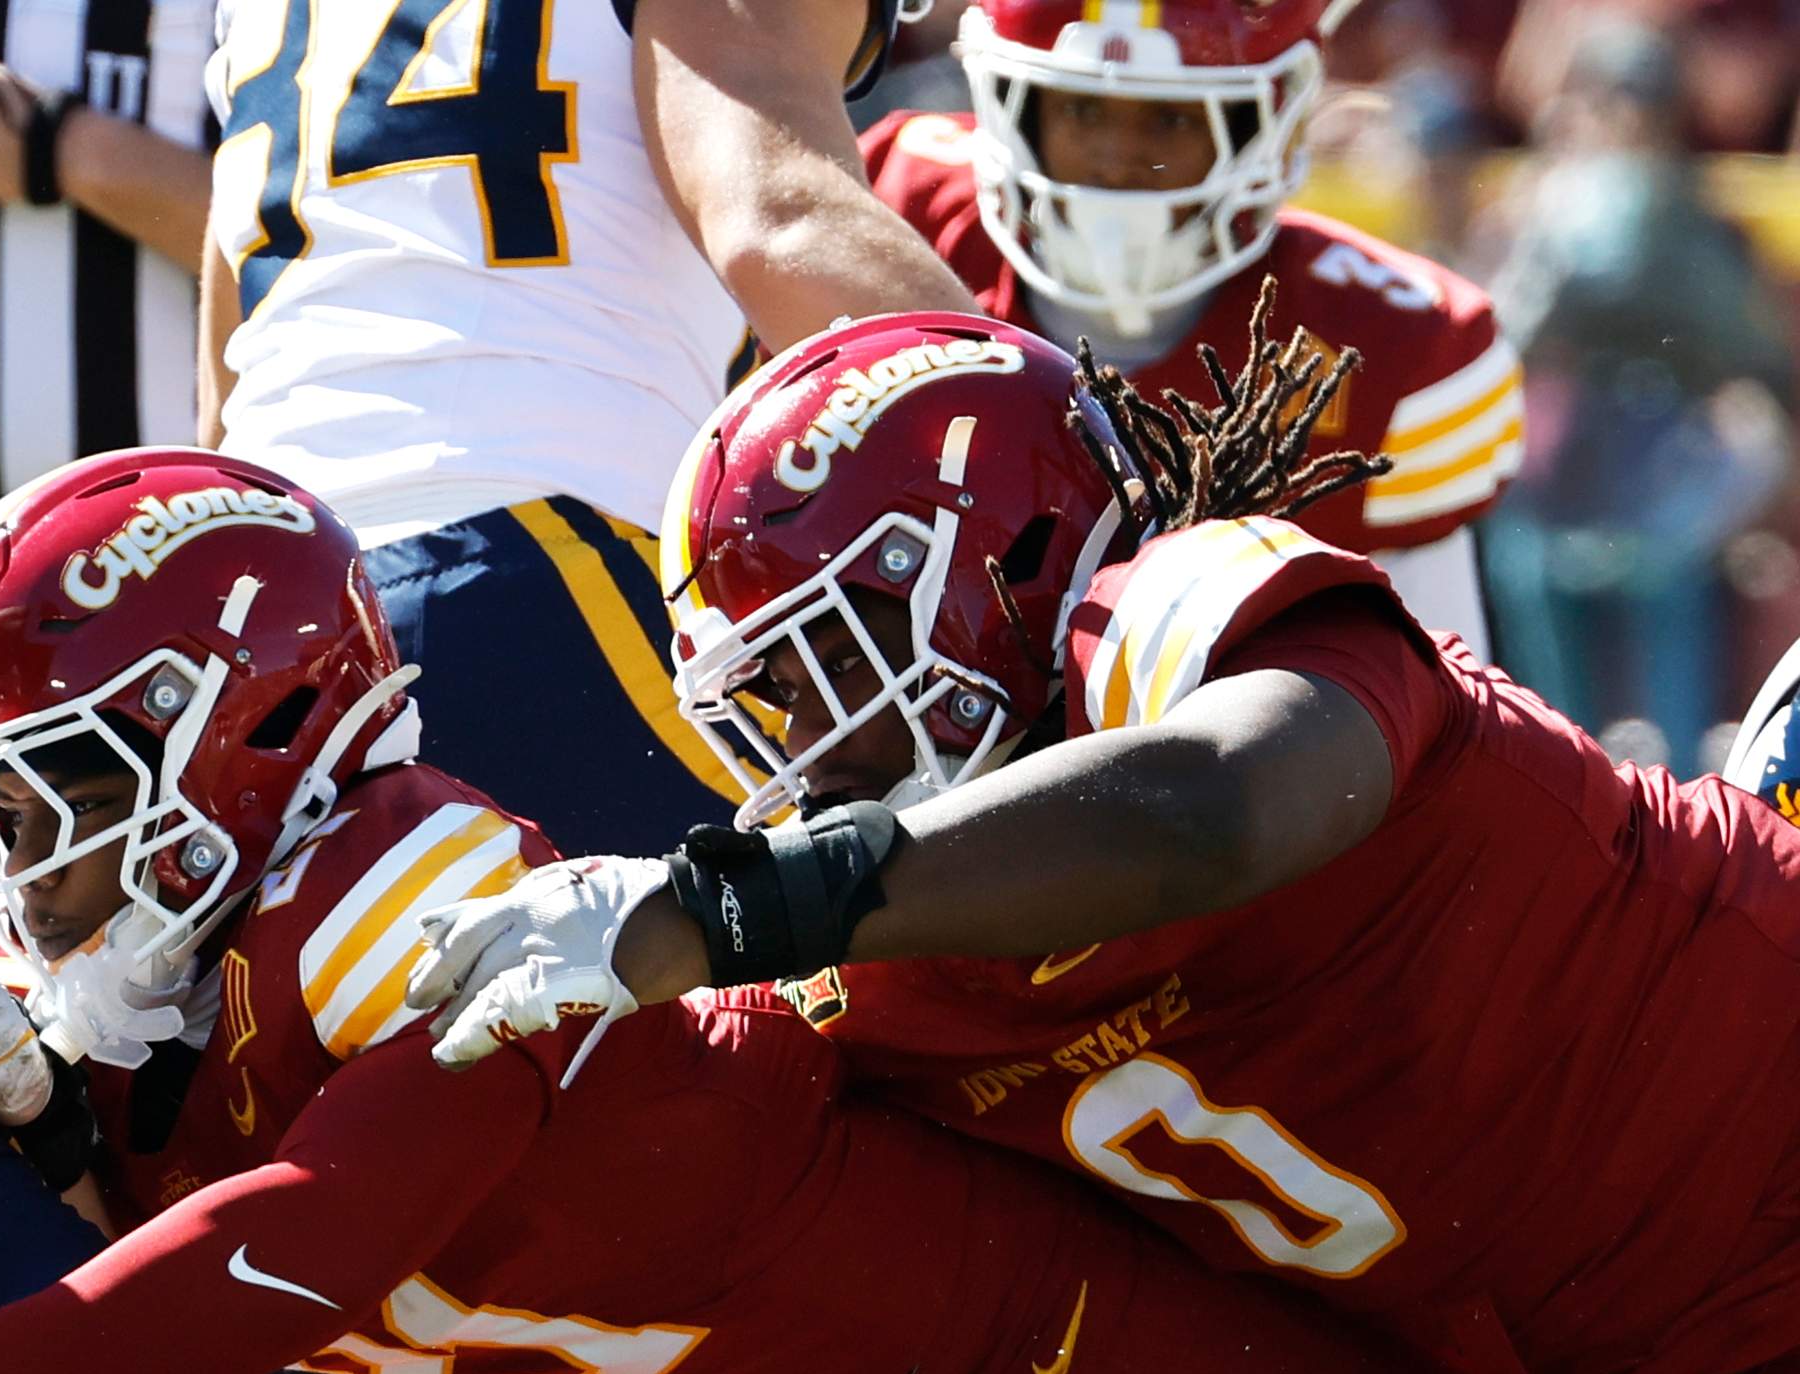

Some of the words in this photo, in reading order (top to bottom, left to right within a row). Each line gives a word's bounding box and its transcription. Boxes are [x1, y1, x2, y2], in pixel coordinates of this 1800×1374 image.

[774, 340, 1026, 493] Cyclones
[61, 488, 316, 609] Cyclones
[1052, 972, 1191, 1074] STATE
[1062, 1051, 1407, 1281] 0
